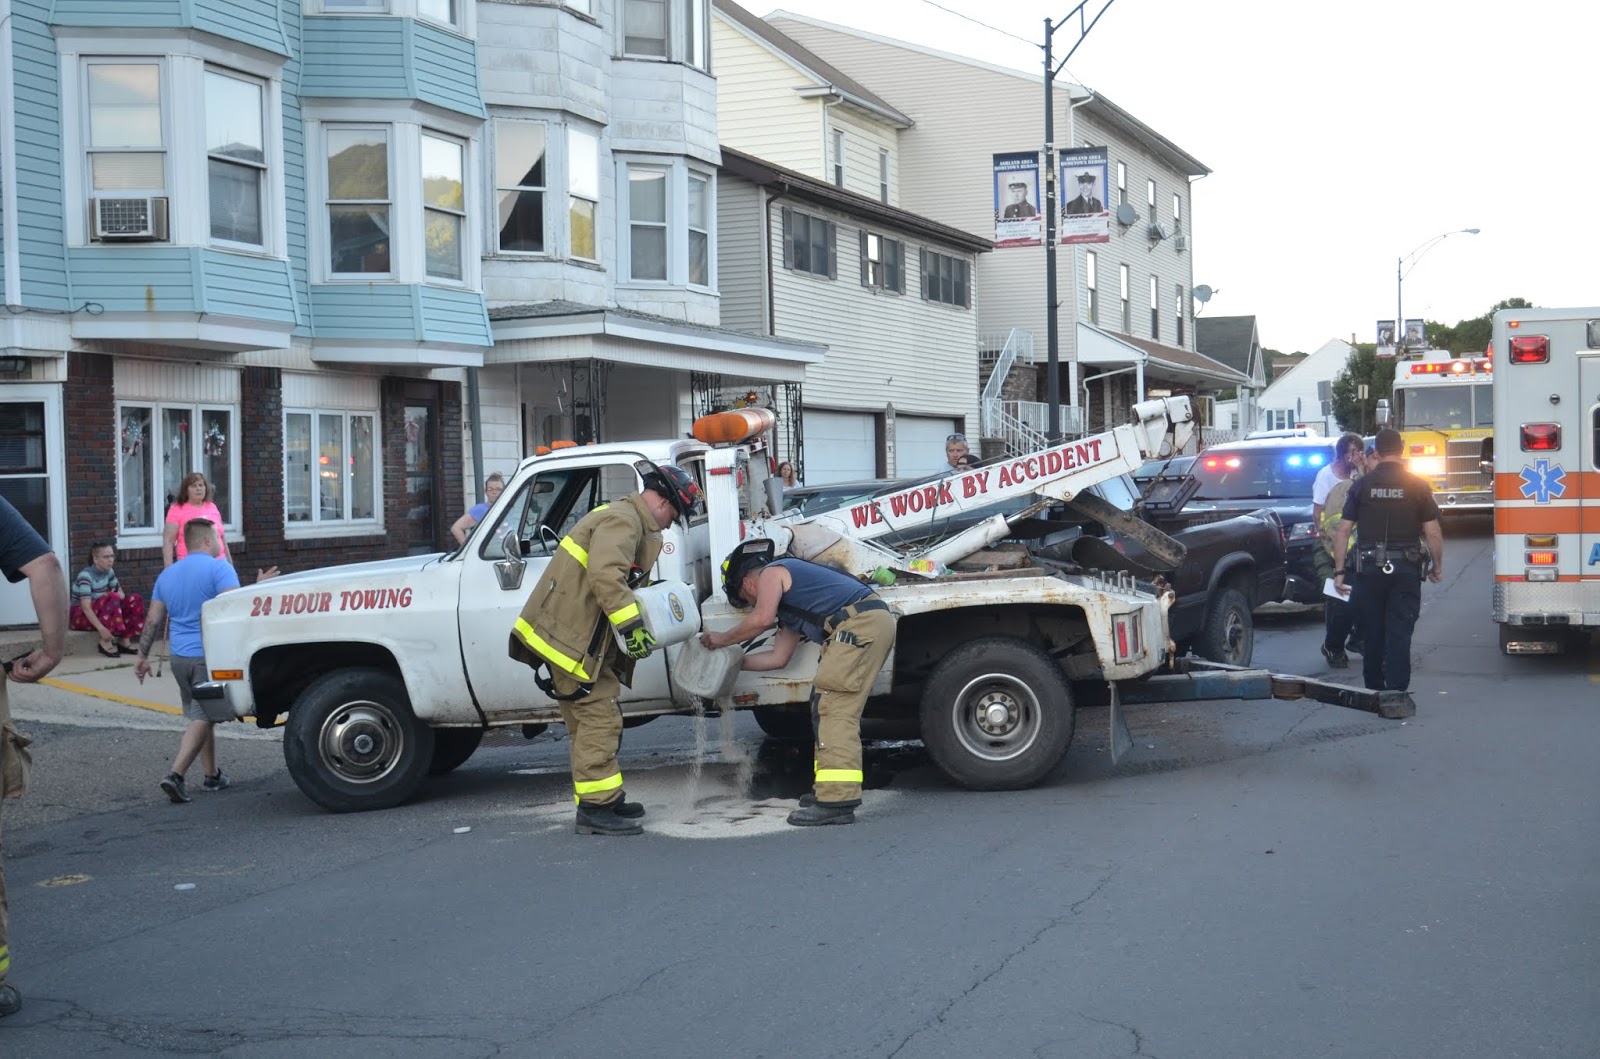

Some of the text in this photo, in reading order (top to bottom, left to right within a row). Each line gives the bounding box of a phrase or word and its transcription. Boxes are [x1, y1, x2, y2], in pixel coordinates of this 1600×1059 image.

[851, 439, 1102, 528] WE WORK BY ACCIDENT
[1370, 488, 1404, 498] POLICE
[250, 587, 413, 617] 24 HOUR TOWING
